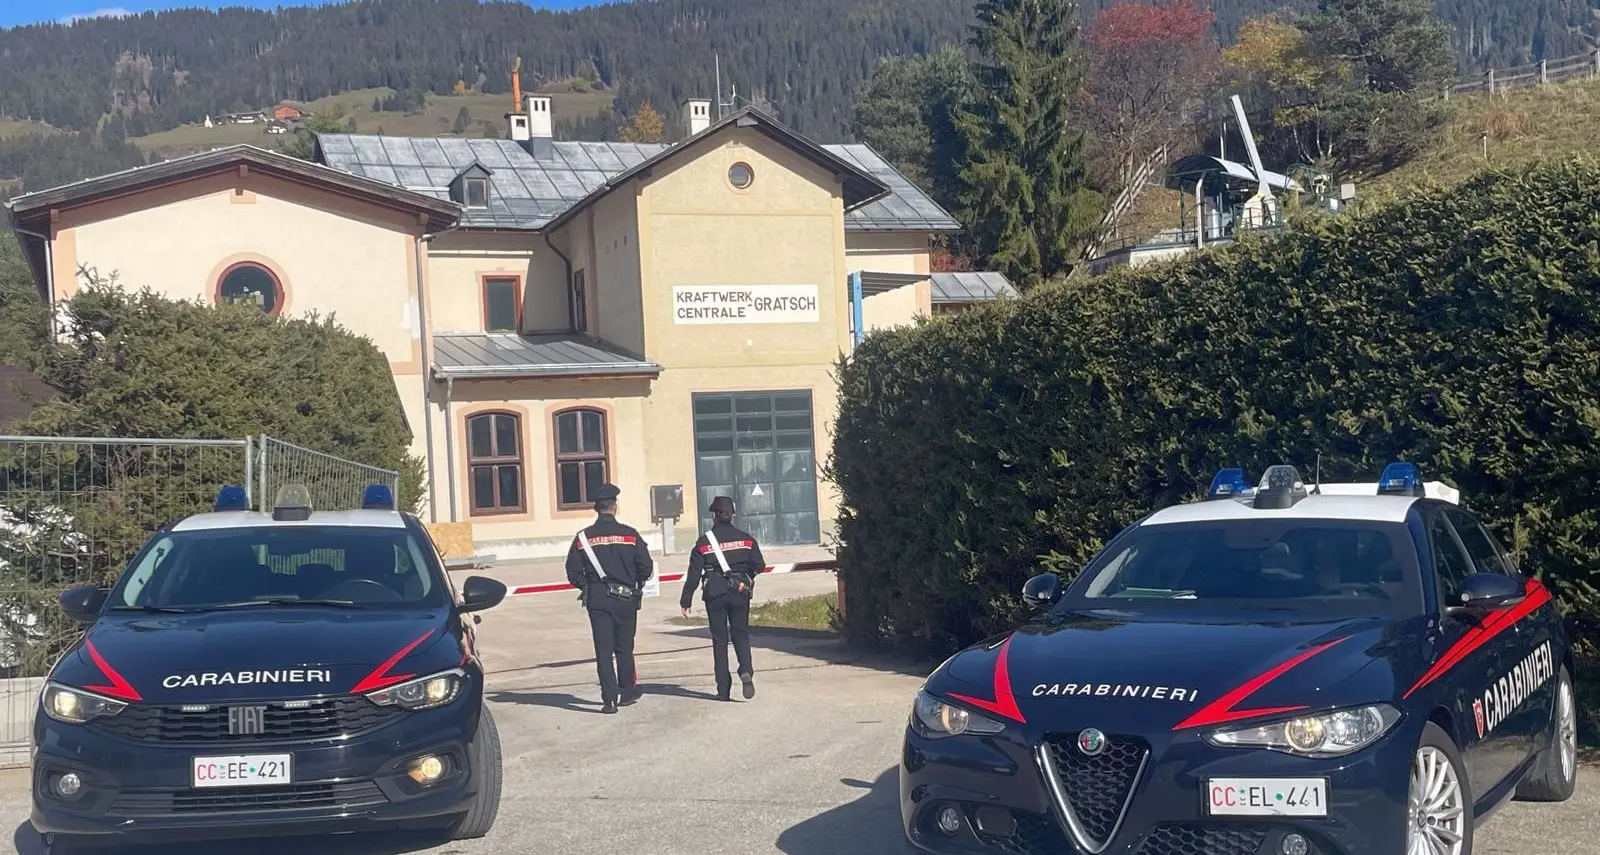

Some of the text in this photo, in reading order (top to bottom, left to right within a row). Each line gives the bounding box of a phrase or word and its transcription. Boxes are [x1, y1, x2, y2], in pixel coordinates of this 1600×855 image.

[676, 291, 753, 303] KRAFTWERK
[677, 307, 746, 319] CENTRALE
[707, 540, 745, 551] CABINIERI
[162, 670, 331, 688] CARABINIERI
[1484, 639, 1553, 732] CARABINIERI
[1031, 683, 1199, 702] CARABINIERI
[228, 706, 268, 735] FIAT
